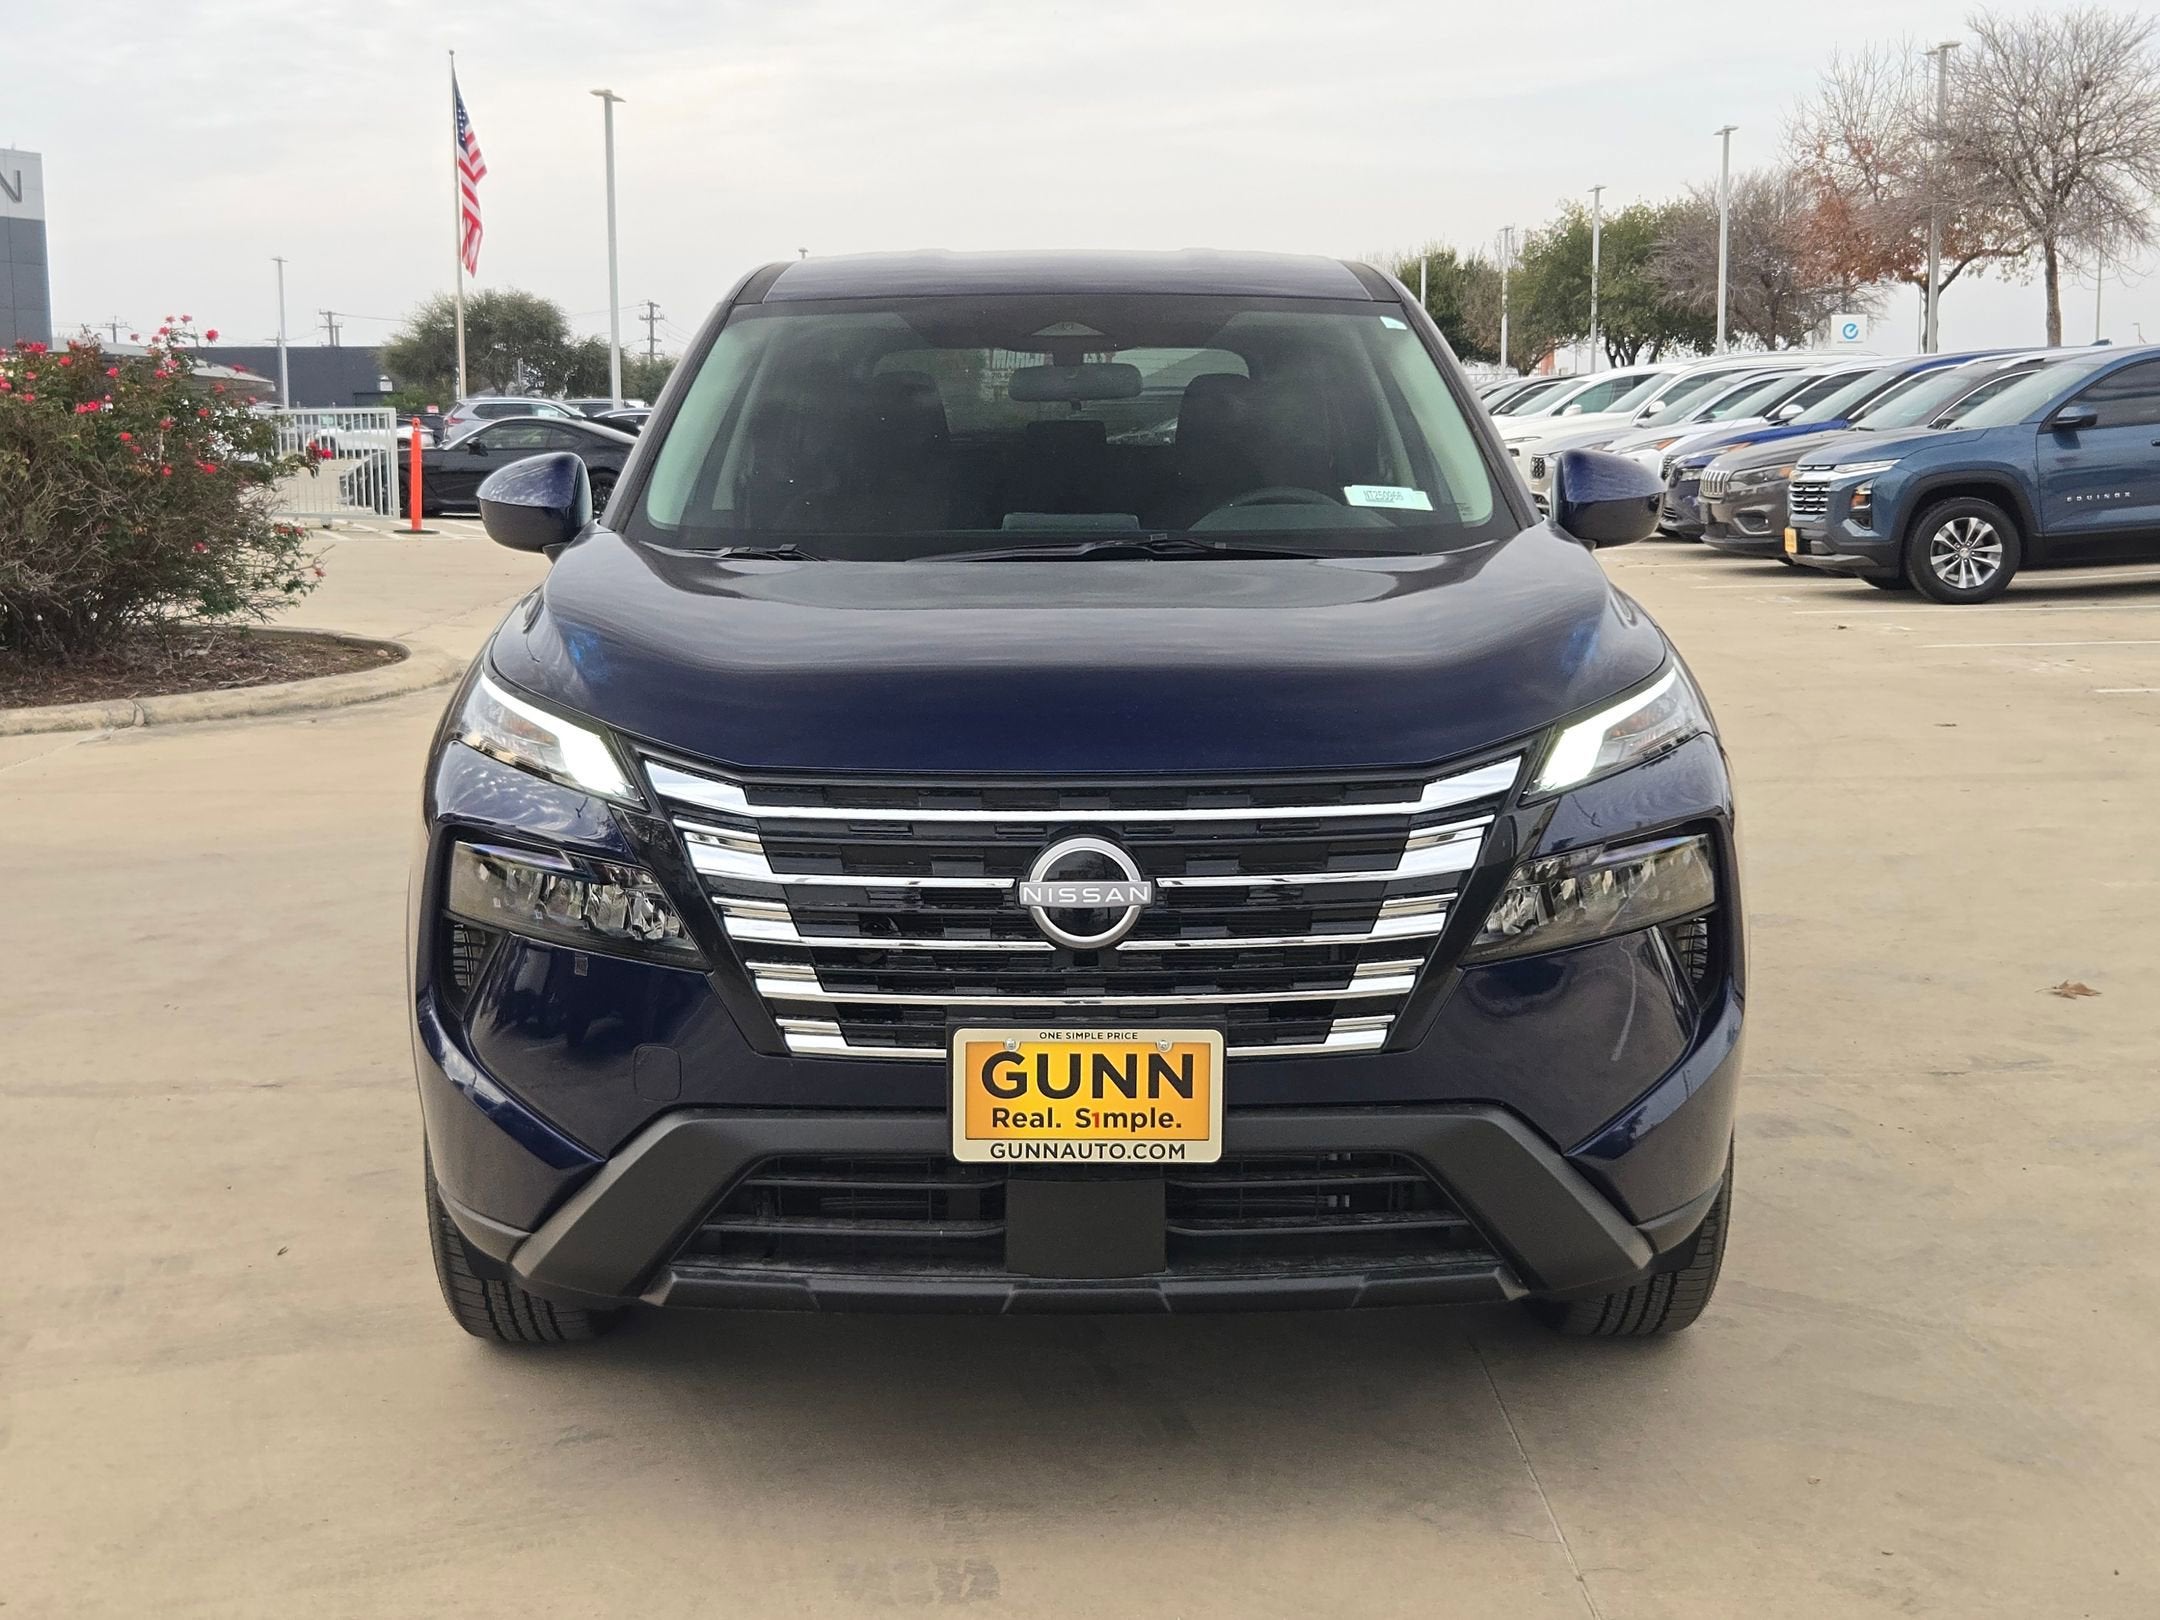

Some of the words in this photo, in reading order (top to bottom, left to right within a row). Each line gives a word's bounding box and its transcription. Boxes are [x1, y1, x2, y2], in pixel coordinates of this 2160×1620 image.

[2066, 491, 2131, 502] EQUINOX
[1022, 885, 1149, 904] NISSAN
[1039, 1031, 1062, 1040] ONE
[1065, 1031, 1103, 1040] SIMPLE
[1107, 1031, 1139, 1040] PRICE
[981, 1051, 1194, 1100] GUNN
[991, 1107, 1062, 1129] Real.
[990, 1142, 1186, 1160] GUNNAUTO.COM
